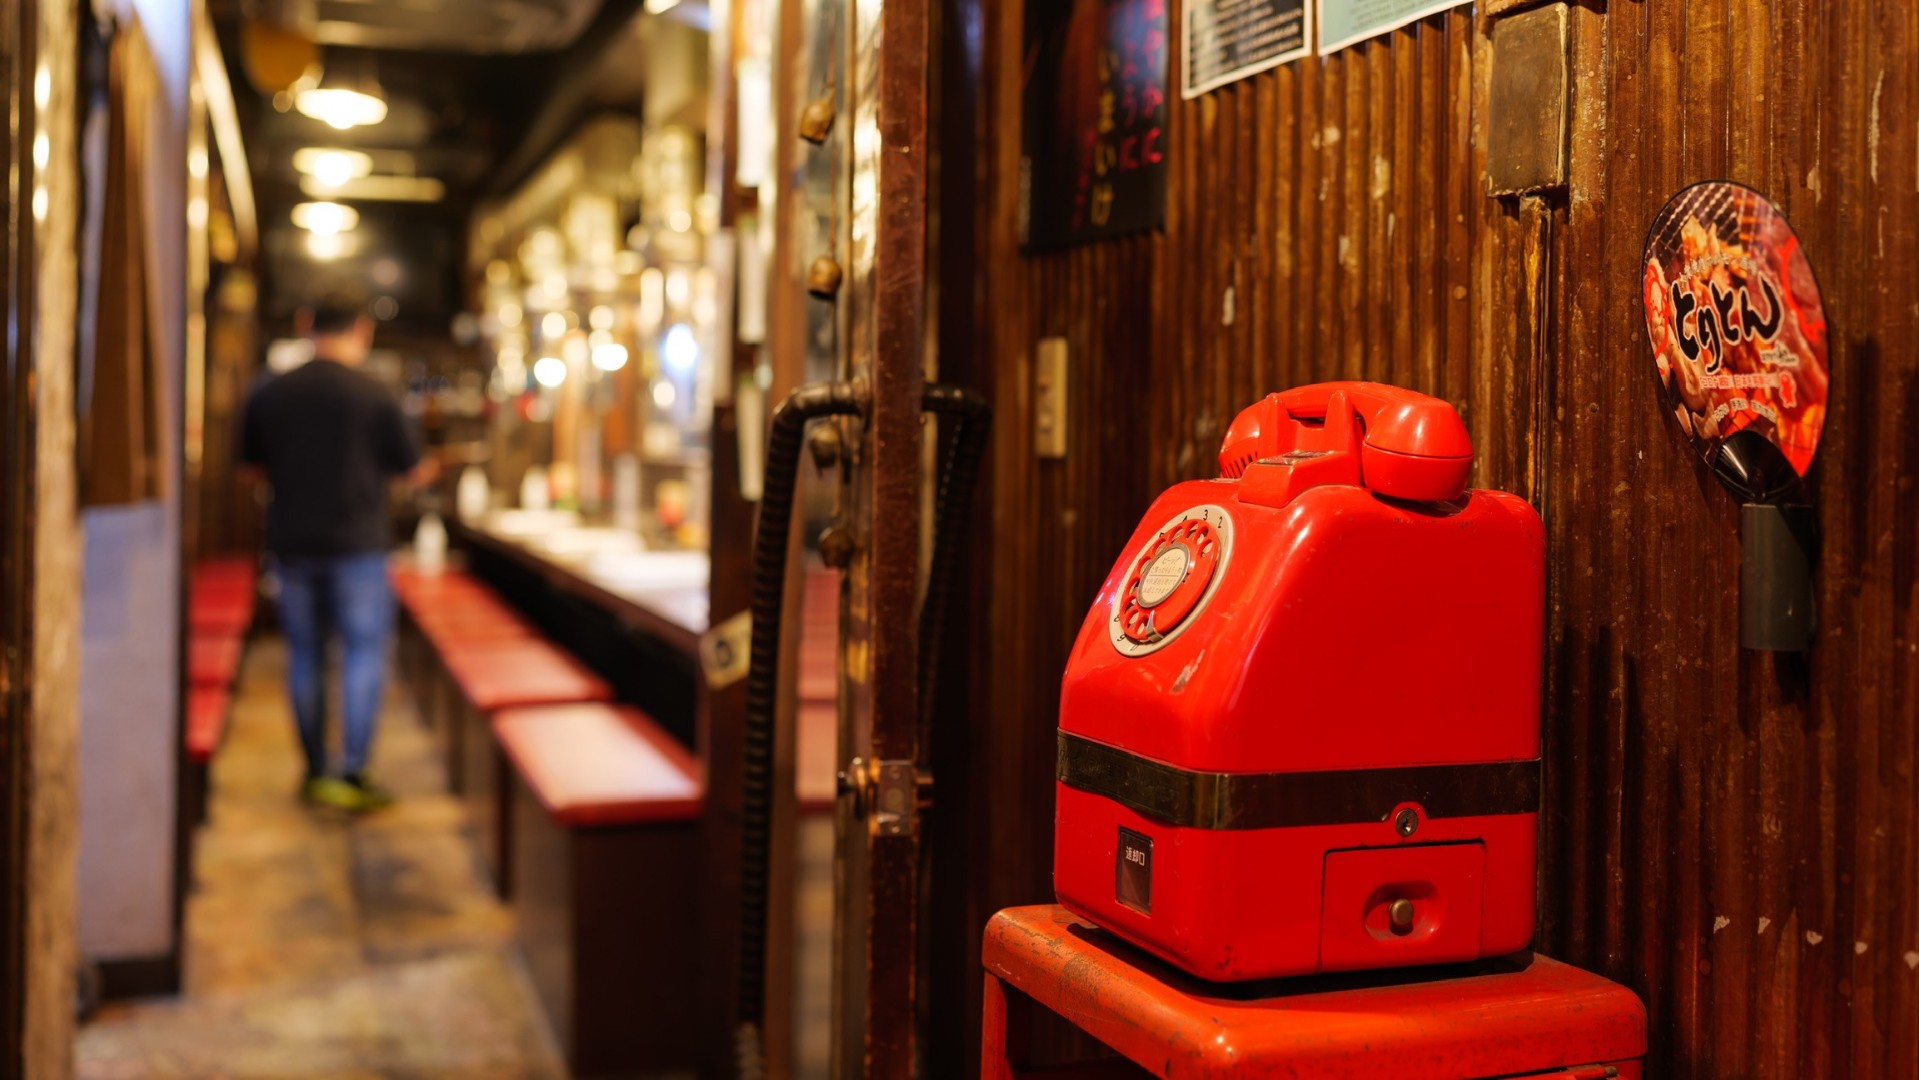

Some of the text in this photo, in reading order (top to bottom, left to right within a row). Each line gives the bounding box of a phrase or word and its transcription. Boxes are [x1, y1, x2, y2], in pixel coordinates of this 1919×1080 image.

[1672, 275, 1782, 374] とりとん
[1203, 509, 1209, 521] 3
[1217, 516, 1223, 528] 2
